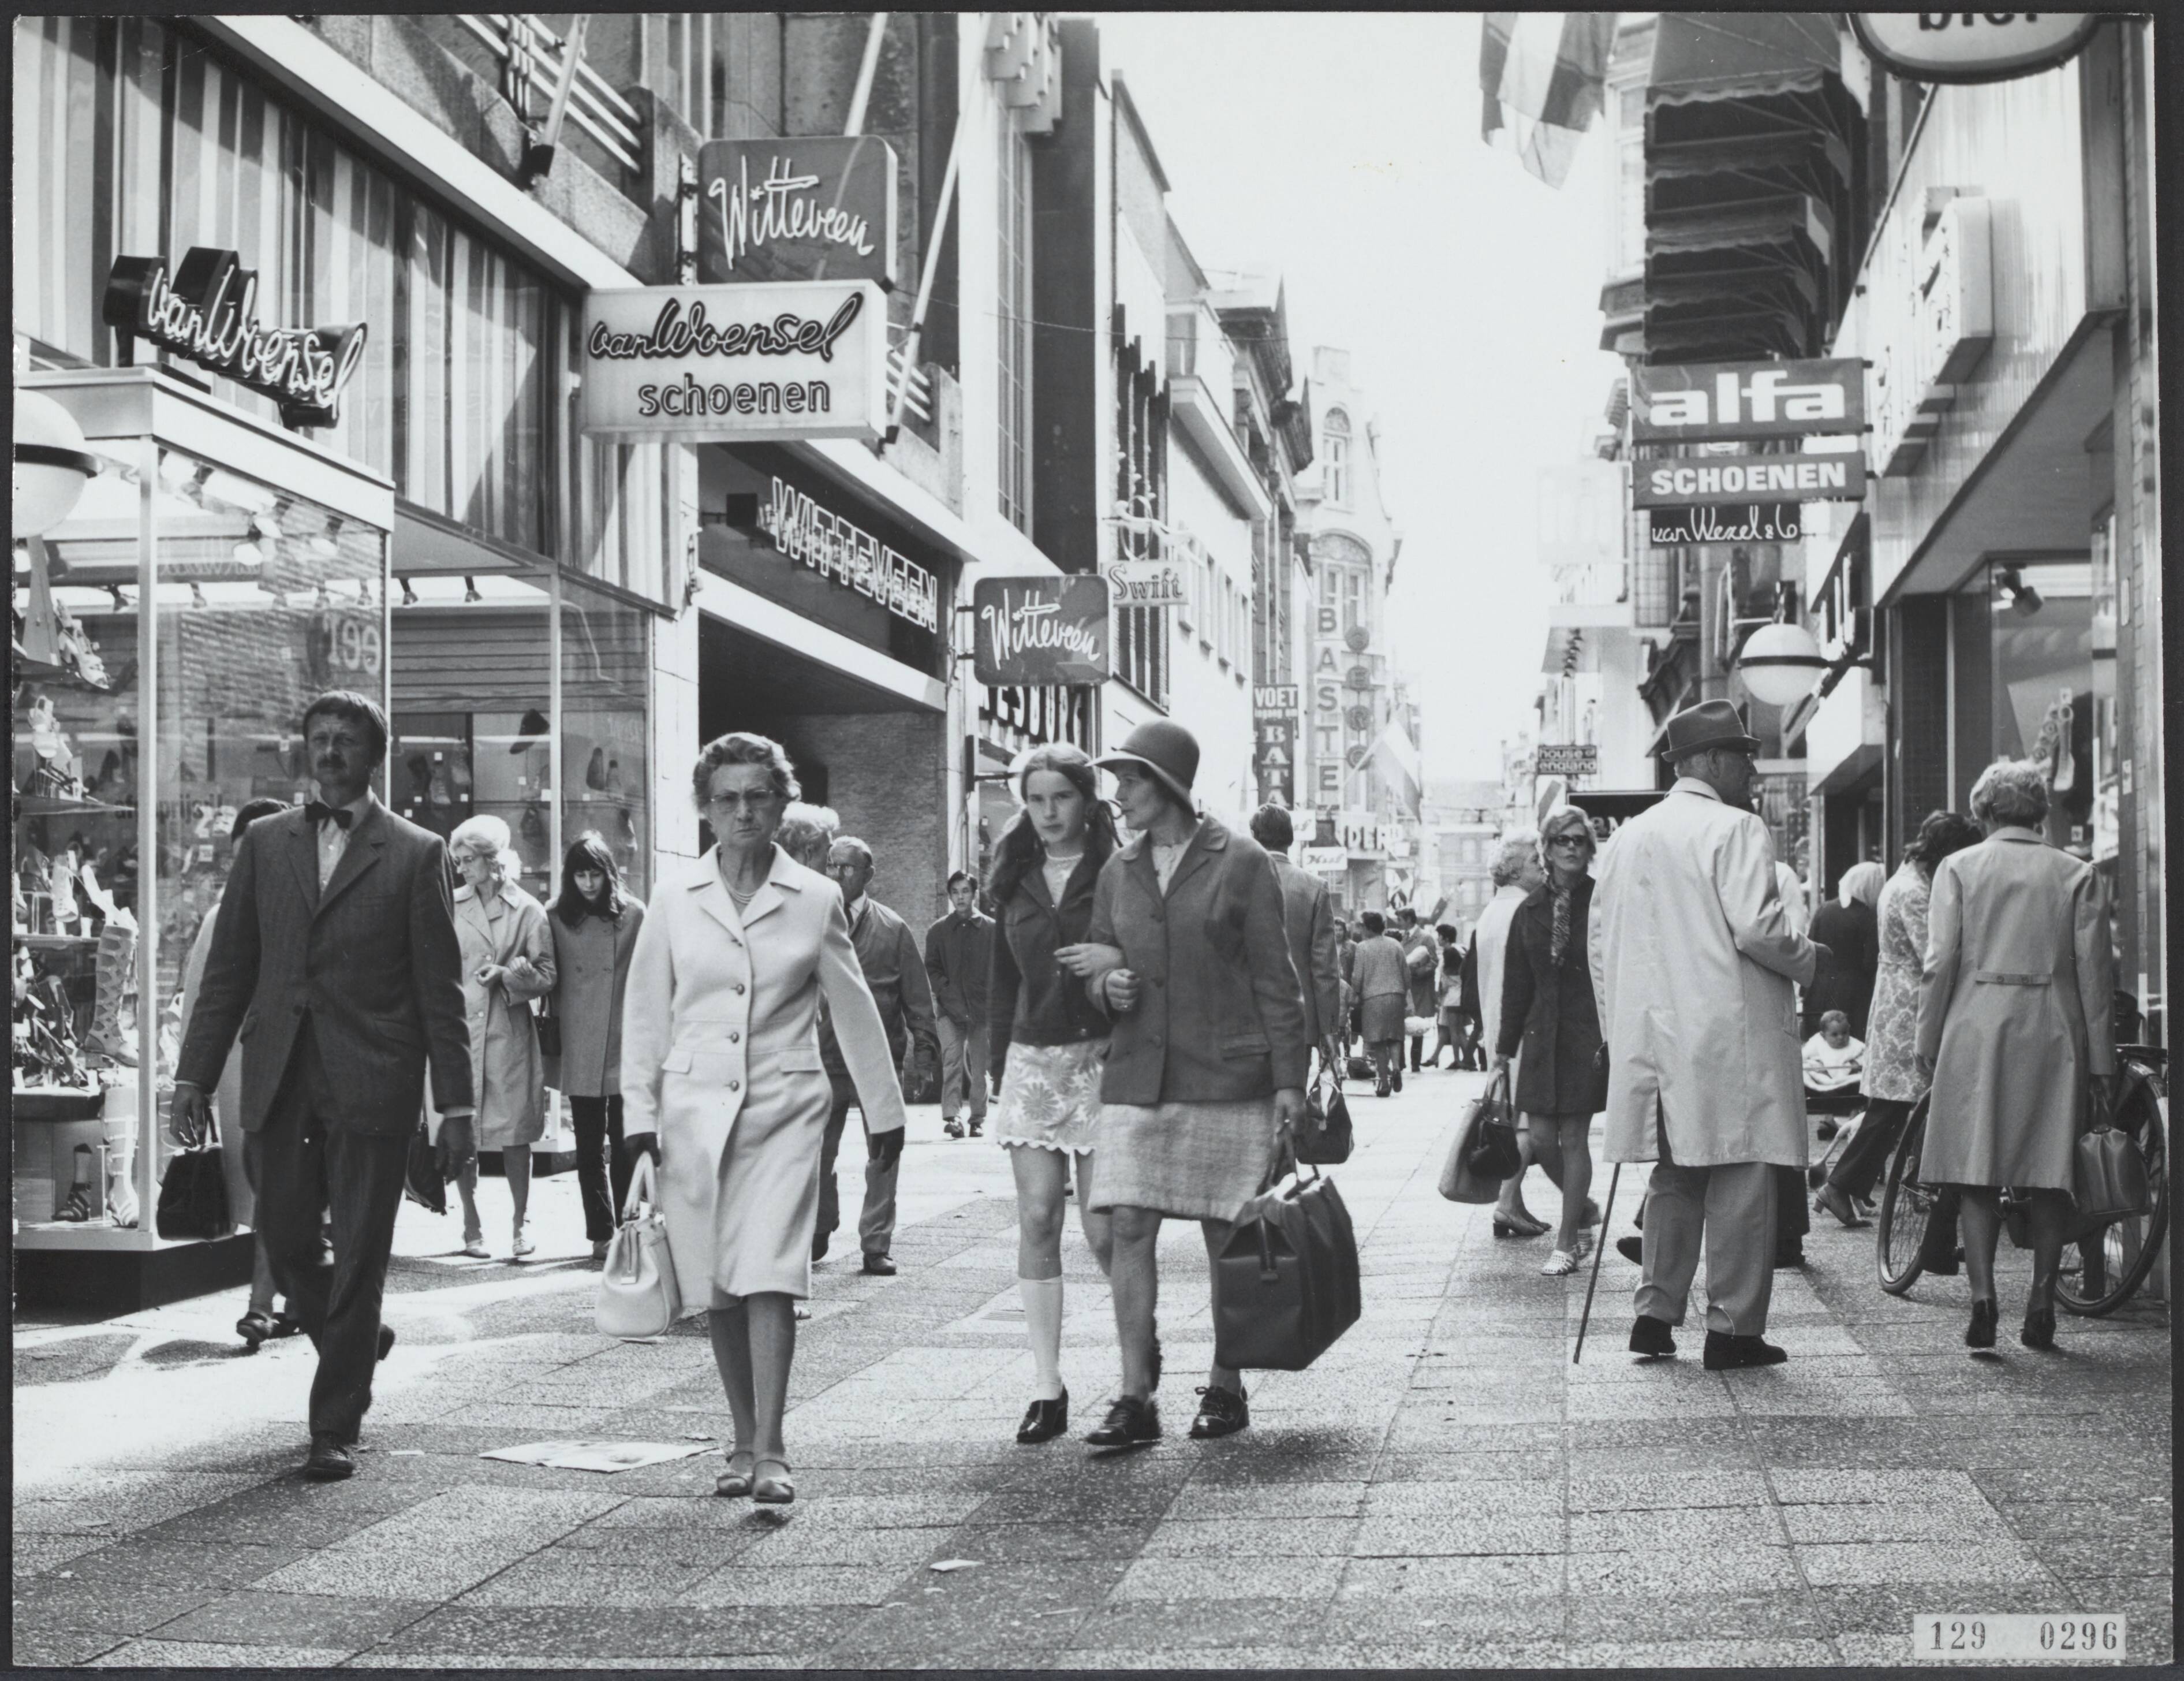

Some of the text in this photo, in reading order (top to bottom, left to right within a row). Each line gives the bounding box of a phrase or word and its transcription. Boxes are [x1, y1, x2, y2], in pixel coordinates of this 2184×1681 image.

[708, 154, 875, 270] Witteveen
[638, 372, 831, 416] schoenen
[1649, 369, 1846, 427] alfa
[1651, 462, 1846, 495] SCHOENEN
[1108, 564, 1183, 600] Swift
[981, 588, 1101, 670] Witteveen
[1254, 687, 1298, 708] VOET
[1261, 725, 1291, 807] BATA
